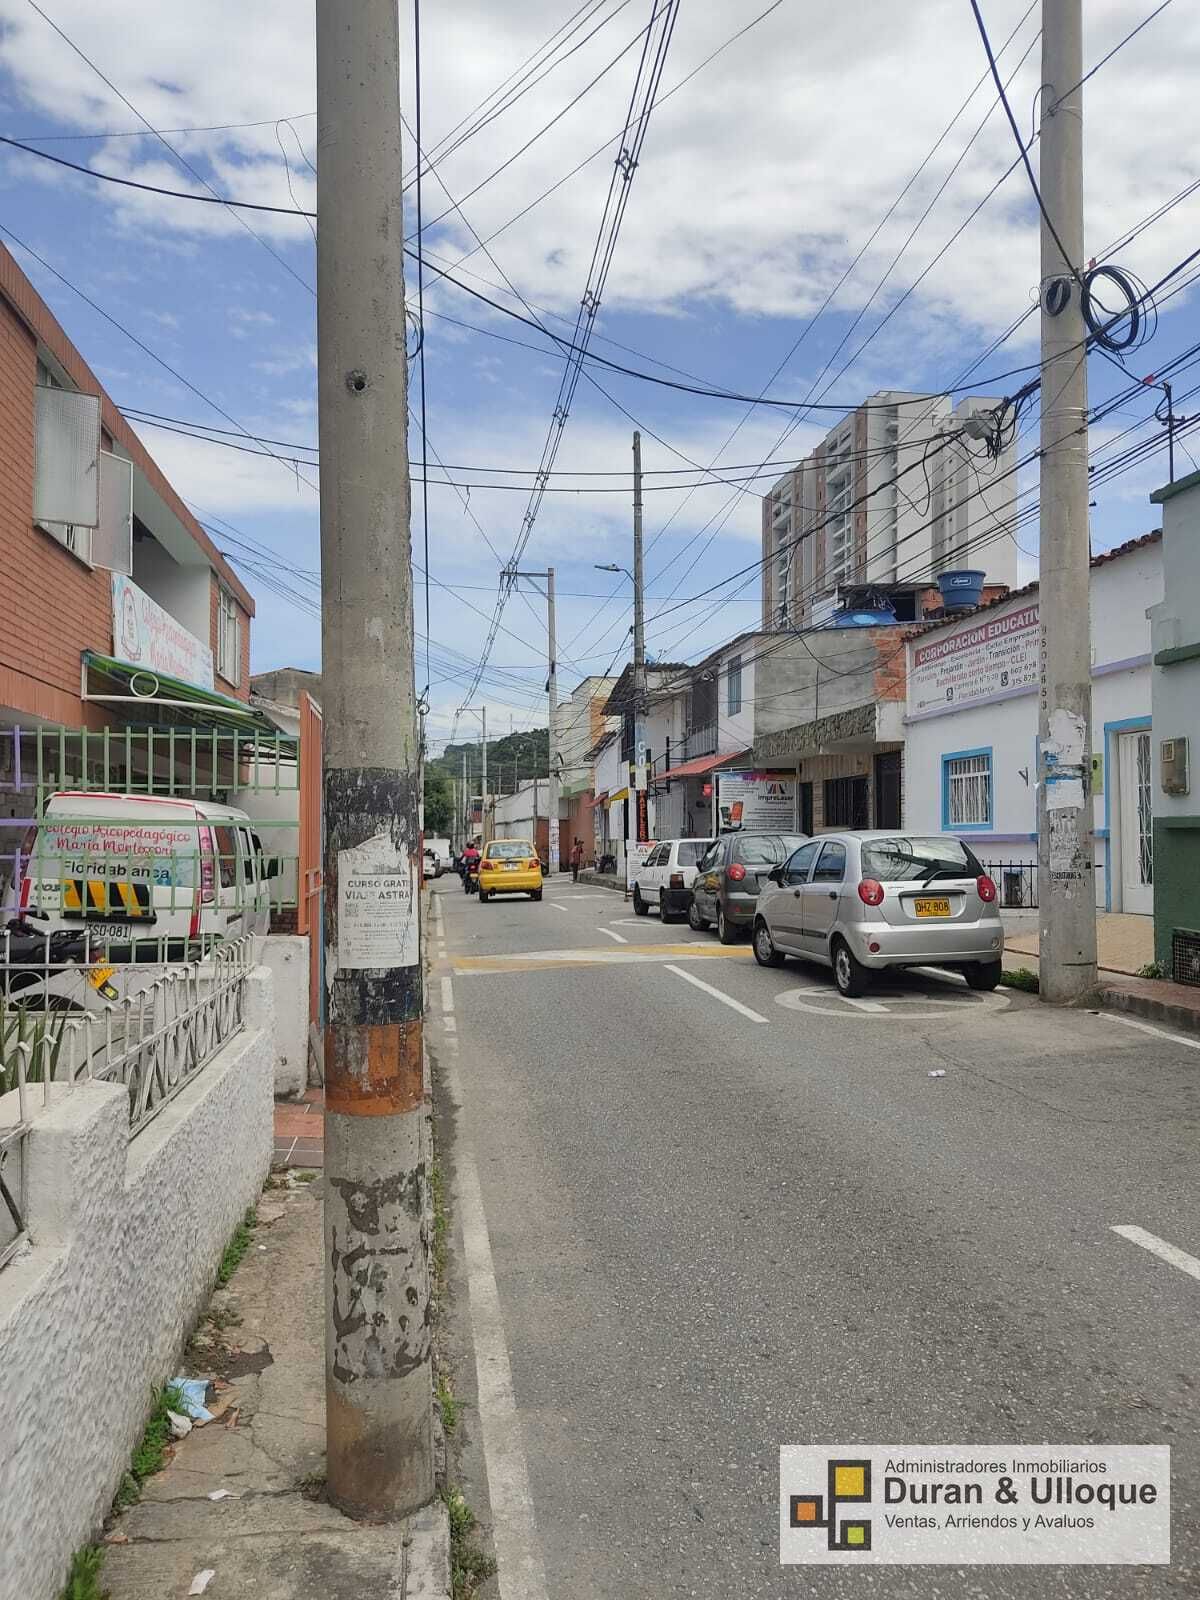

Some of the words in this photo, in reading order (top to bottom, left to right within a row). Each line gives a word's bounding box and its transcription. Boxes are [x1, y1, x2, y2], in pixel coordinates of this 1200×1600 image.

[64, 860, 170, 880] Floridabanca
[347, 880, 381, 888] CURSO
[383, 880, 409, 888] GRATI
[378, 890, 410, 900] ASTRA
